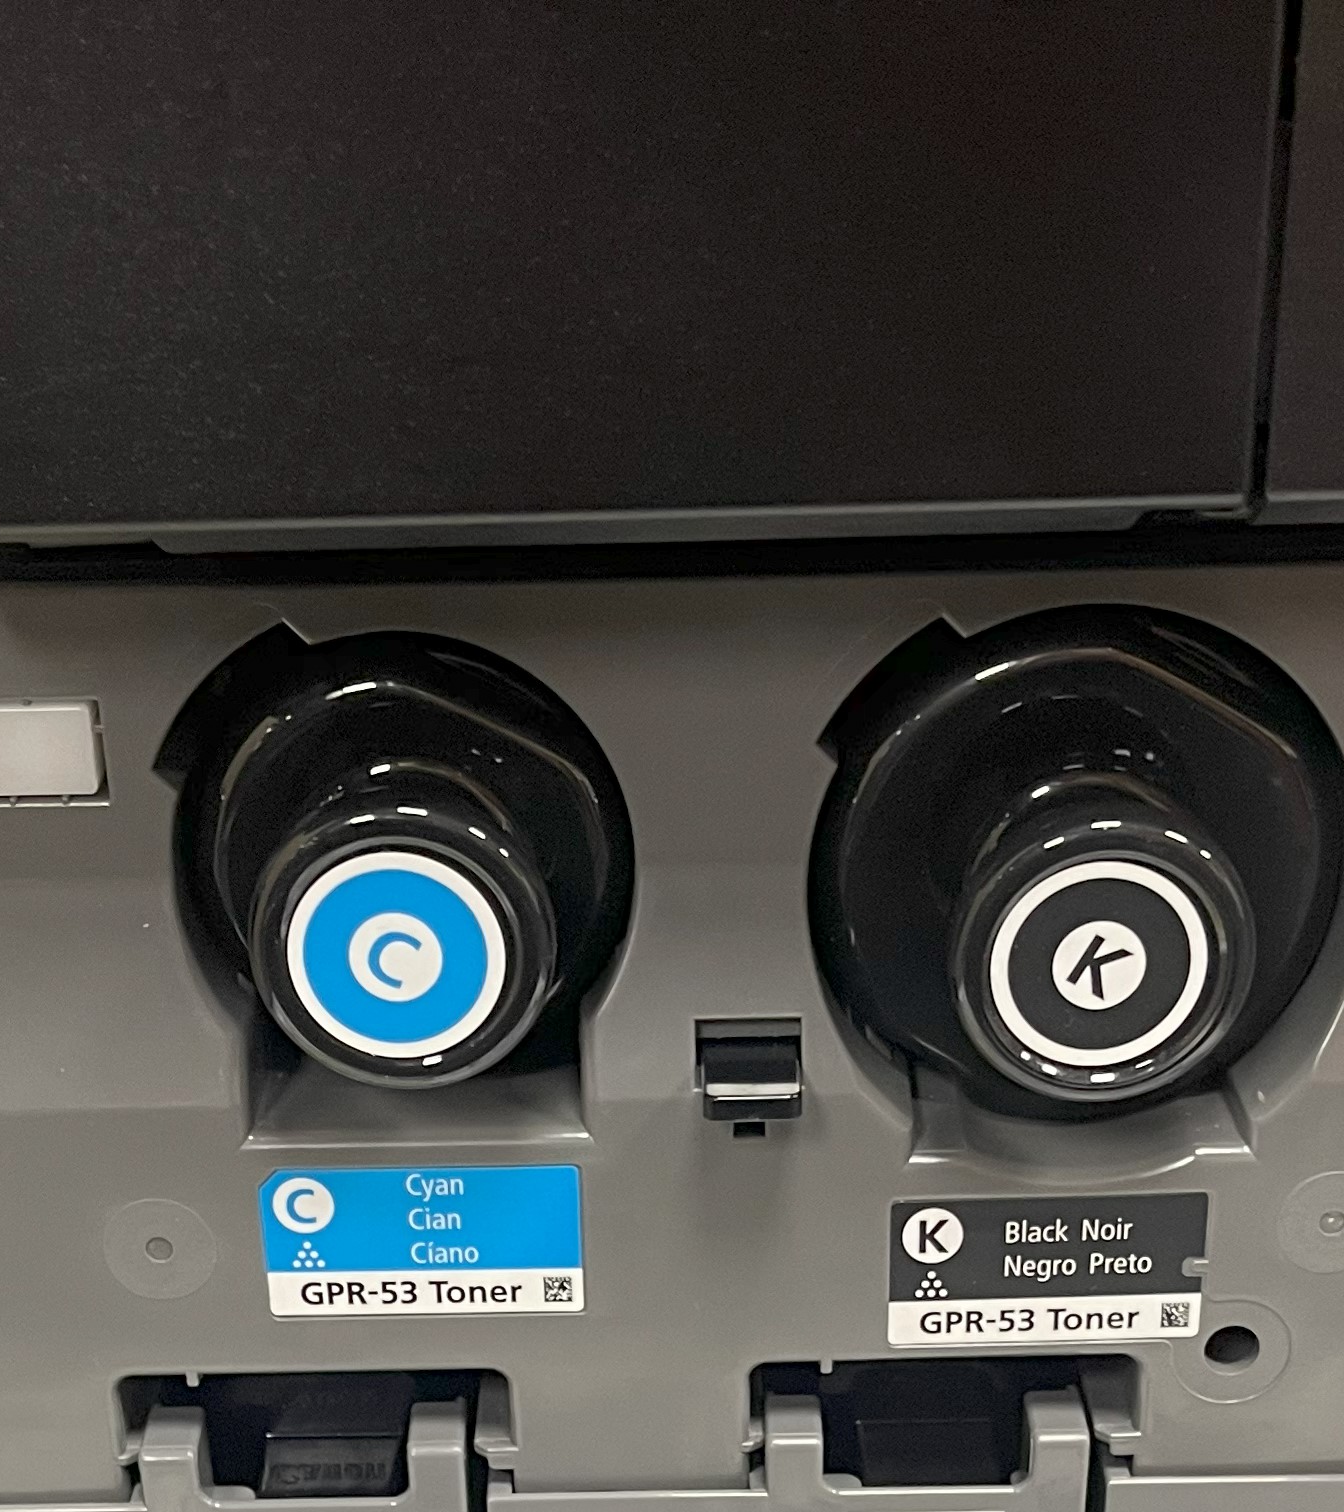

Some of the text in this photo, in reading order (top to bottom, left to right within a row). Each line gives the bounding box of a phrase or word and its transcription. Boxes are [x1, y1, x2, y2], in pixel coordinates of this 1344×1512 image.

[367, 930, 422, 989] C
[1065, 934, 1133, 1001] K
[405, 1173, 465, 1201] Cyan
[286, 1189, 317, 1224] C
[918, 1219, 949, 1254] K
[1005, 1218, 1134, 1244] Black Noir
[1003, 1253, 1152, 1282] Negro Preto
[300, 1280, 522, 1305] GPR-53 Toner
[920, 1308, 1140, 1334] GPR-53 Toner
